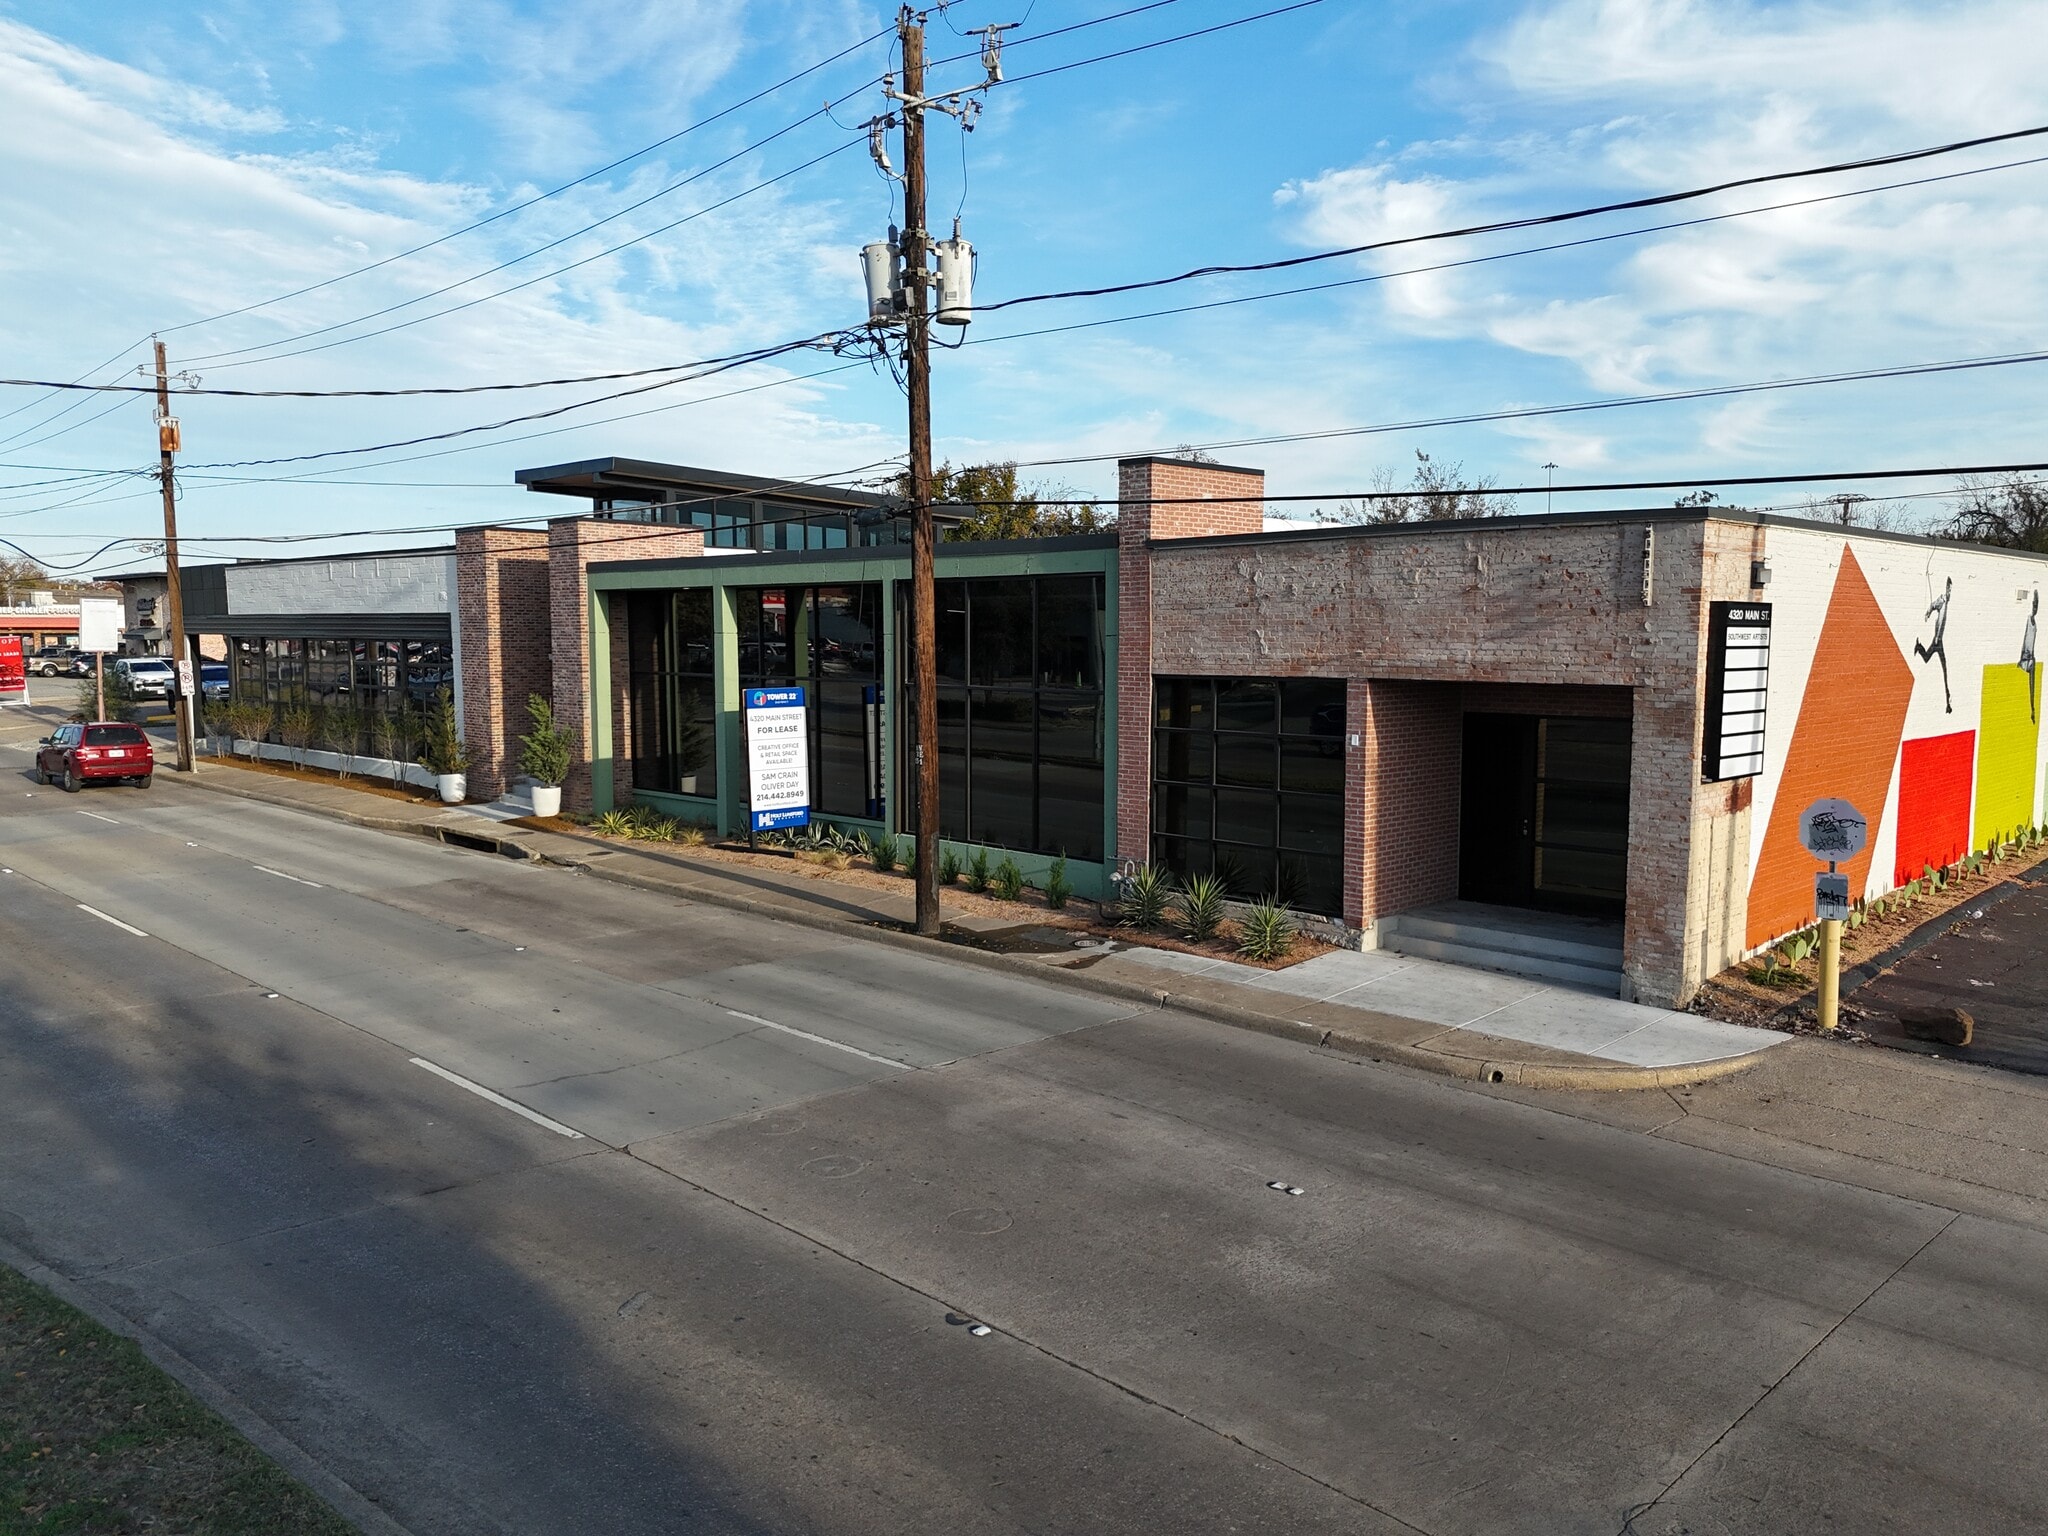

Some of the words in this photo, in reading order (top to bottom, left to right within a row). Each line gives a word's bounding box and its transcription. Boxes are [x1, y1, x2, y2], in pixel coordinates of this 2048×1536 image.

[1728, 610, 1744, 620] 4320
[1745, 610, 1760, 620] MAIN
[1761, 611, 1770, 620] ST.
[766, 693, 788, 701] TOWER
[788, 692, 797, 700] 22
[781, 713, 802, 721] STREET
[757, 726, 773, 734] FOR
[774, 725, 798, 733] LEASE
[781, 742, 799, 750] OFFICE
[761, 772, 777, 780] SAM
[777, 771, 799, 779] CRAIN
[760, 782, 785, 791] OLIVER
[786, 781, 799, 789] DAY
[756, 790, 804, 801] 214.442.8949
